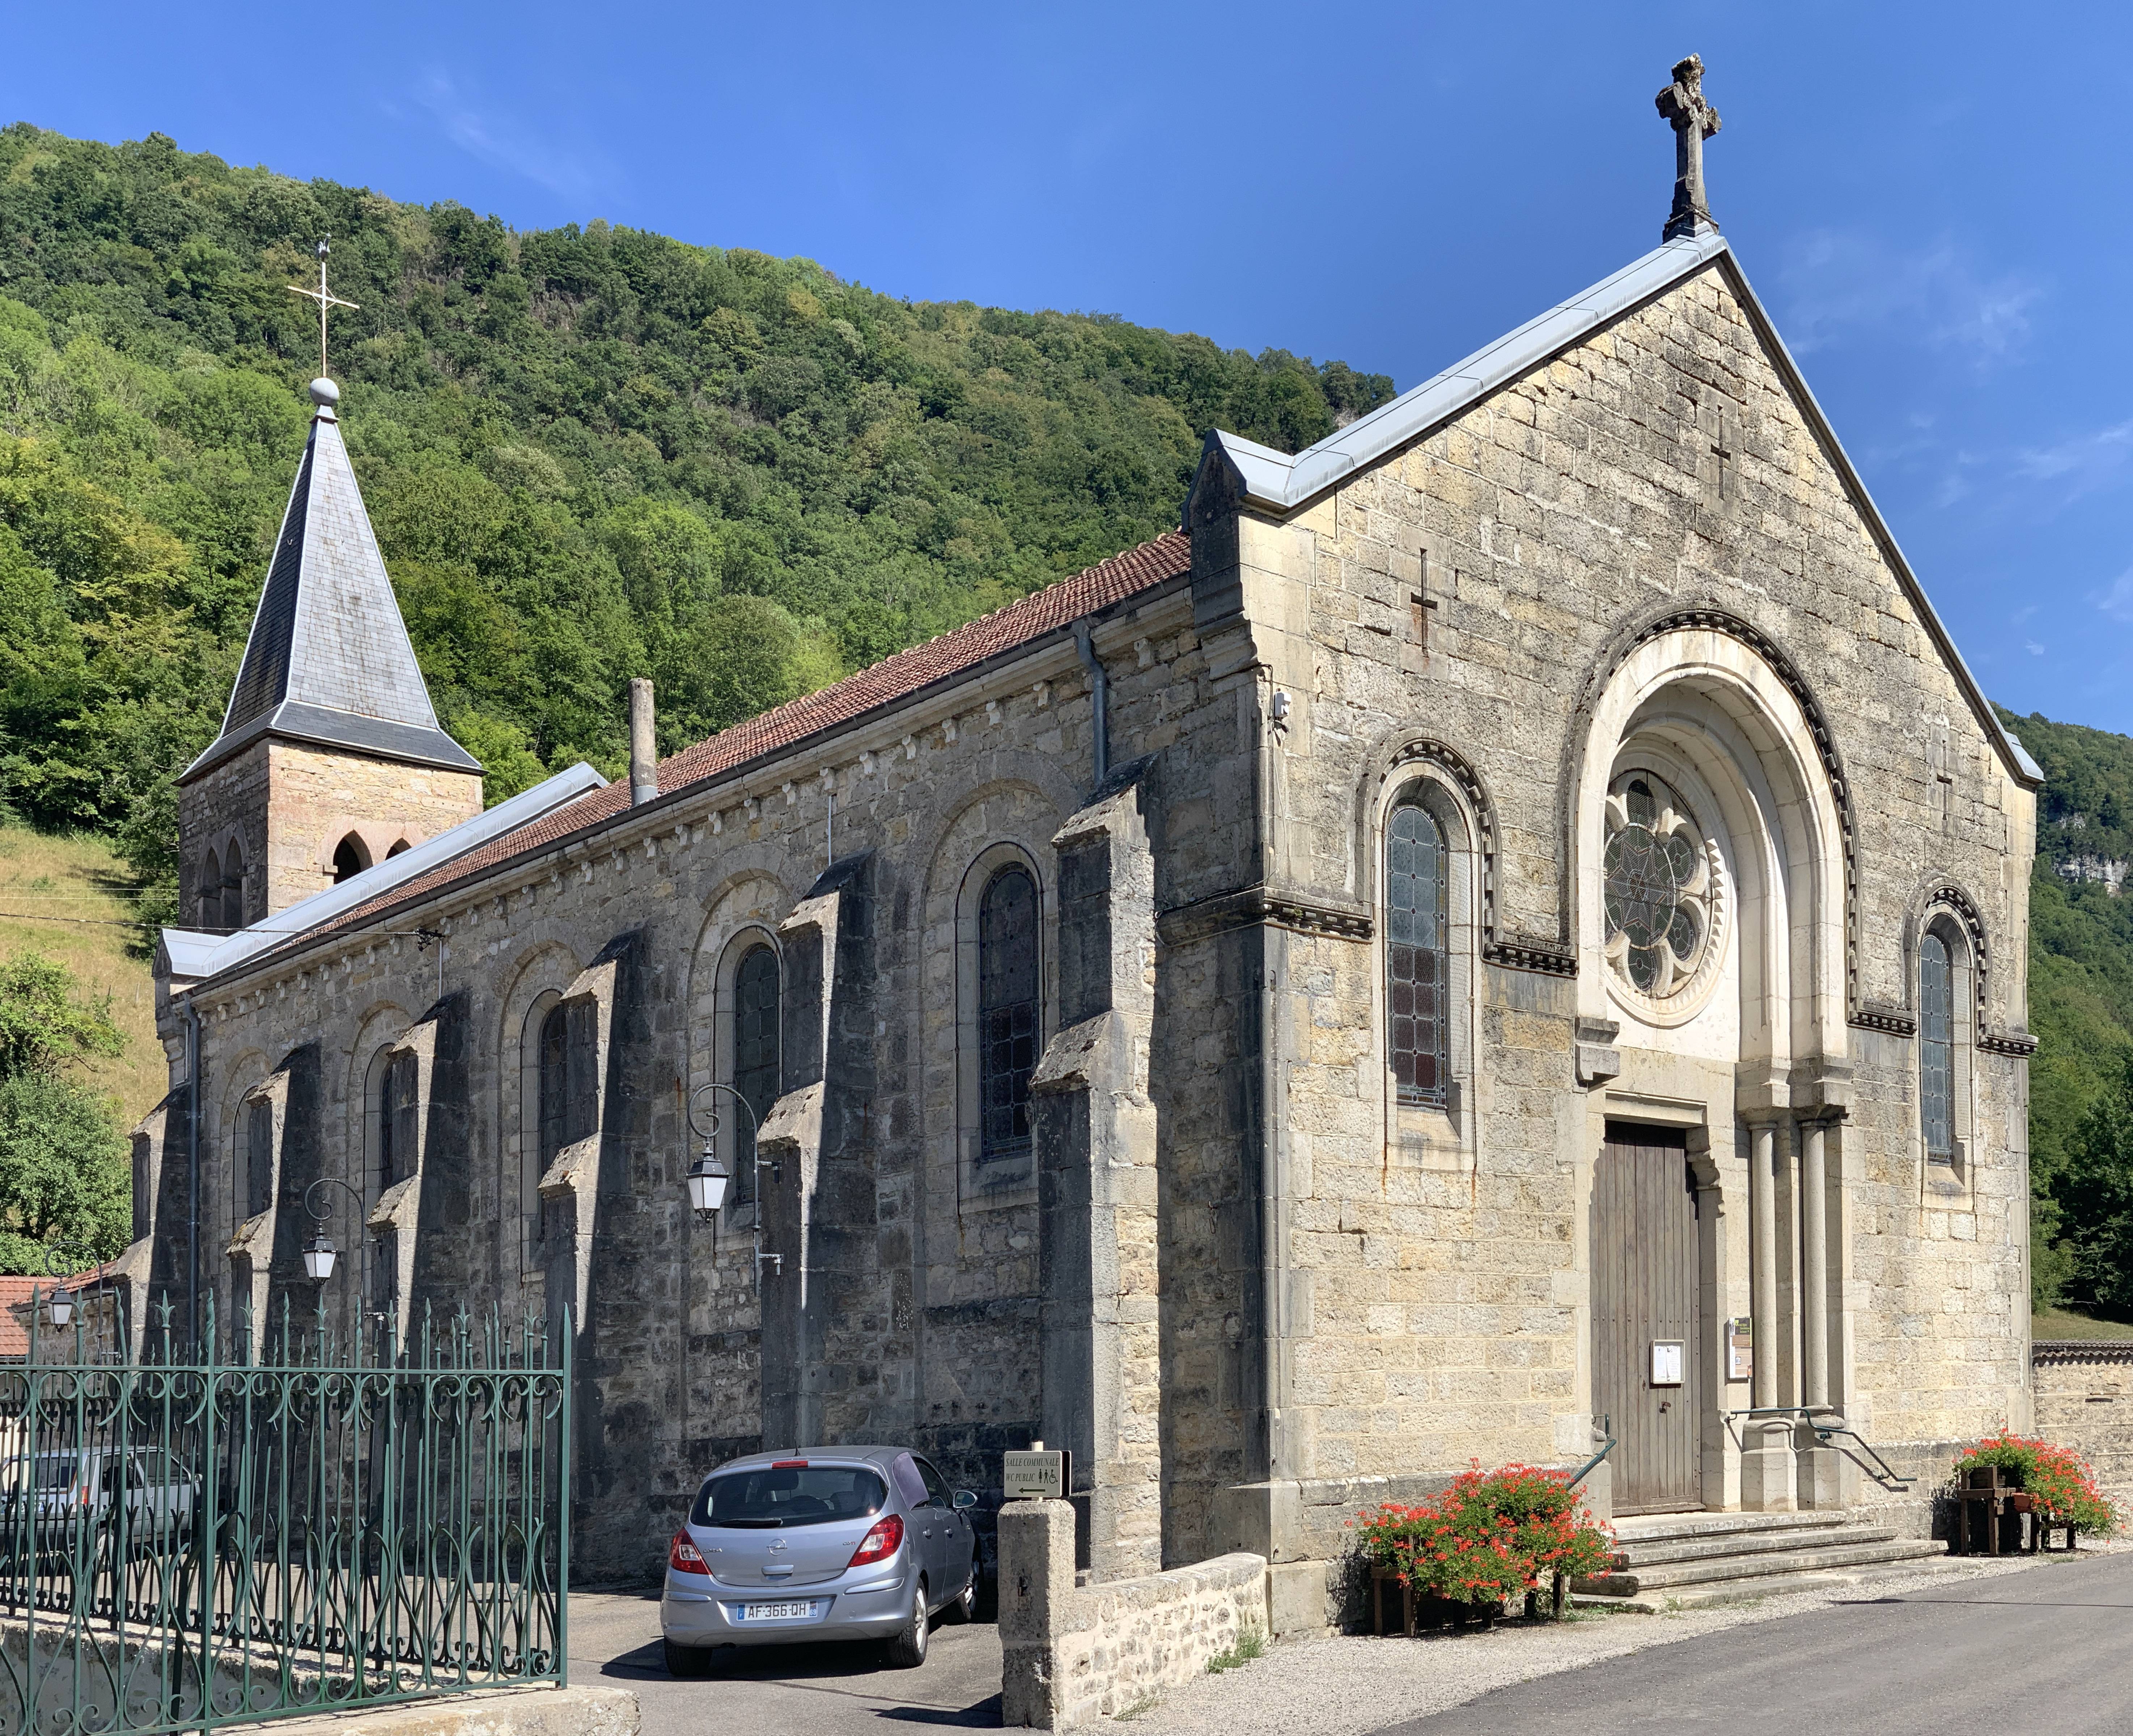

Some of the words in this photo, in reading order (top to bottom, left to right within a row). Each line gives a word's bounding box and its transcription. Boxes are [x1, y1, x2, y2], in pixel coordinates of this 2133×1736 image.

[1005, 1458, 1022, 1467] SALLE
[1023, 1458, 1059, 1467] COMMUNALE
[1006, 1473, 1015, 1482] WC
[1015, 1473, 1035, 1482] PUBLIC
[748, 1603, 806, 1618] AF-366-QH
